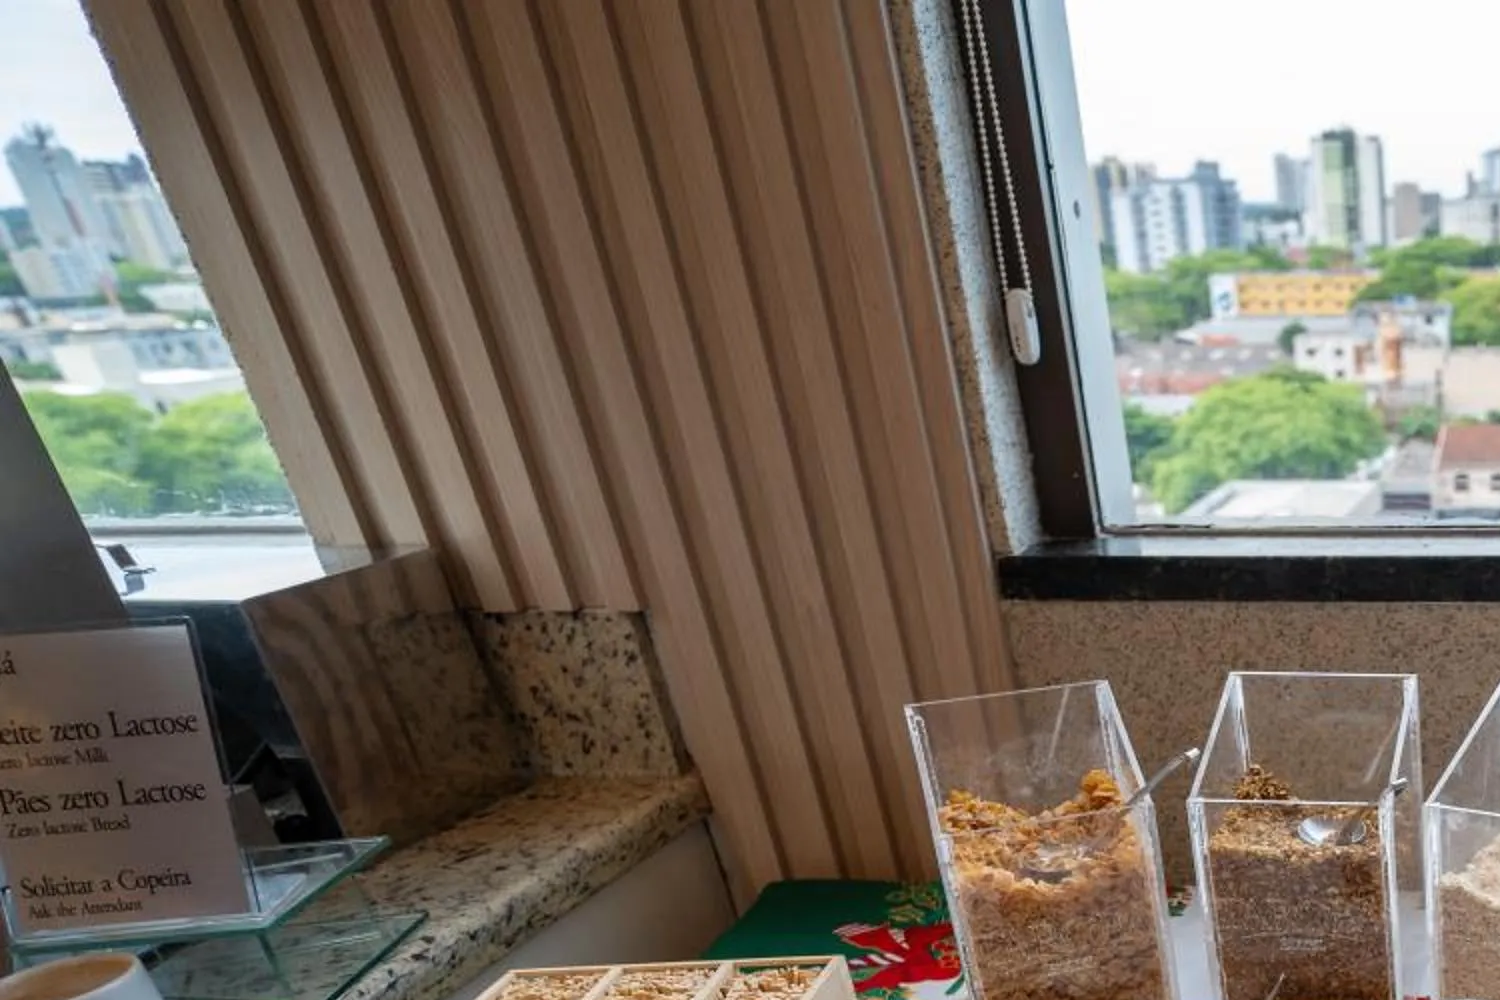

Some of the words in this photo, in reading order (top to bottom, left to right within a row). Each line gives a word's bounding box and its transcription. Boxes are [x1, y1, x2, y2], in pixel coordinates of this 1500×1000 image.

[0, 719, 43, 745] eite
[50, 722, 100, 742] zero
[107, 711, 199, 738] Lactose
[0, 758, 23, 769] ero
[58, 790, 109, 811] zero
[117, 780, 207, 806] Lactose
[91, 814, 131, 832] Bread
[20, 873, 94, 899] Solicitar
[102, 880, 112, 892] a
[118, 867, 192, 895] Copeira
[57, 901, 77, 917] the
